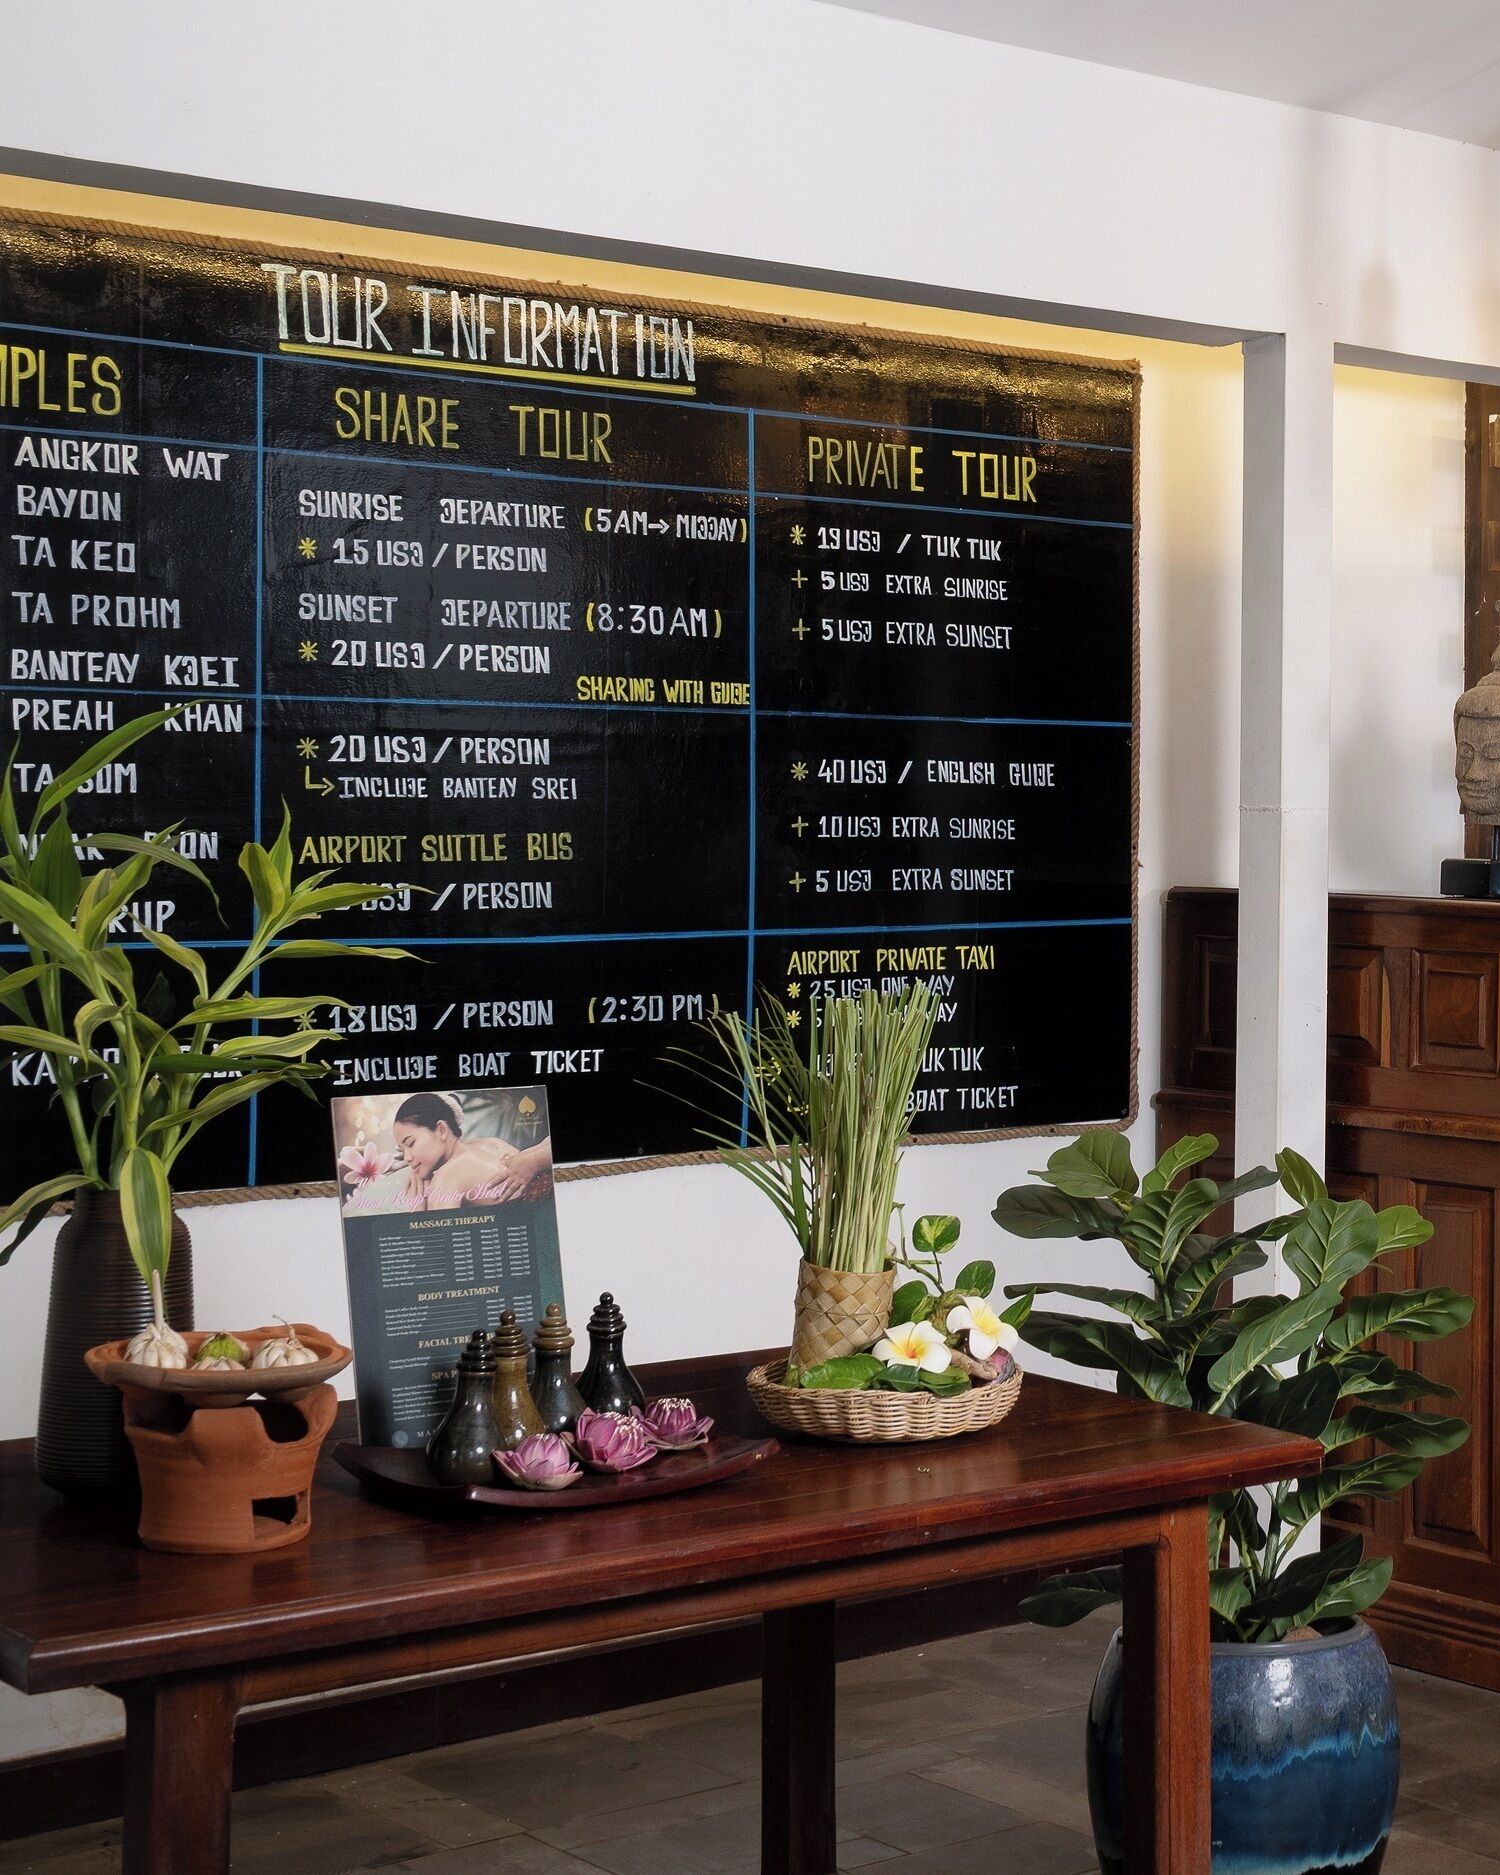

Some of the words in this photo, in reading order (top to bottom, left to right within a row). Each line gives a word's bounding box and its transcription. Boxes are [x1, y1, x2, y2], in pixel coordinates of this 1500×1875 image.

[261, 263, 393, 351] TOUR
[407, 284, 696, 381] INFORMATION
[0, 344, 121, 416] PLES
[335, 387, 460, 450] SHARE
[509, 405, 612, 464] TOUR
[14, 437, 139, 476] ANGKOR
[163, 448, 229, 481] WAT
[808, 436, 924, 492] PRIVATE
[952, 450, 1037, 503] TOUR
[17, 485, 121, 522] BAYON
[299, 489, 404, 522] SUNRISE
[440, 498, 565, 530] DEPARTURE
[12, 534, 56, 568] TA
[71, 542, 136, 573] KEO
[333, 538, 369, 566] 15
[377, 541, 423, 567] USD
[455, 544, 547, 573] PERSON
[846, 529, 880, 552] USD
[921, 535, 960, 559] TUK
[967, 538, 1002, 561] TUK
[821, 571, 835, 590] 5
[839, 572, 869, 592] USD
[886, 574, 932, 596] EXTRA
[944, 577, 1008, 601] SUNRISE
[12, 592, 54, 624] TA
[72, 595, 181, 629] PROHM
[299, 593, 398, 624] SUNSET
[441, 599, 571, 631] DEPARTURE
[821, 619, 834, 640] 5
[838, 619, 872, 643] USD
[886, 621, 936, 646] EXTRA
[946, 623, 1012, 650] SUNSET
[11, 649, 139, 682] BANTEAY
[331, 640, 365, 668] 20
[376, 642, 425, 669] USD
[459, 644, 551, 674] PERSON
[576, 676, 655, 702] SHARING
[663, 679, 703, 704] WITH
[711, 681, 750, 705] GUIDE
[12, 698, 114, 731] PREAH
[164, 702, 243, 733] KHAN
[328, 735, 365, 762] 20
[374, 735, 426, 763] USD
[460, 737, 550, 766] PERSON
[13, 763, 55, 793] TA
[338, 776, 428, 799] INCLUDE
[442, 777, 517, 799] BANTEAY
[532, 777, 577, 800] SREI
[818, 759, 845, 784] 40
[850, 759, 886, 785] USD
[927, 760, 995, 785] ENGLISH
[1009, 763, 1055, 787] GUIDE
[818, 816, 843, 838] 10
[847, 816, 881, 838] USD
[892, 816, 939, 839] EXTRA
[949, 817, 1016, 840] SUNRISE
[299, 835, 406, 865] AIRPORT
[421, 833, 507, 862] SUTTLE
[528, 832, 573, 861] BUS
[463, 882, 552, 910] PERSON
[815, 870, 830, 892] 5
[836, 869, 872, 892] USD
[892, 868, 943, 891] EXTRA
[950, 868, 1014, 892] SUNSET
[787, 950, 860, 975] AIRPORT
[877, 947, 947, 971] PRIVATE
[955, 945, 995, 970] TAXI
[809, 980, 843, 999] 25
[329, 1005, 366, 1033] 18
[370, 1004, 417, 1032] USD
[463, 1000, 553, 1029] PERSON
[332, 1055, 438, 1085] INCLUDE
[458, 1052, 510, 1077] BOAT
[530, 1049, 604, 1074] TICKET
[949, 1047, 984, 1071] TUK
[957, 1085, 1018, 1110] TICKET
[409, 1217, 453, 1230] MASSAGE
[454, 1215, 496, 1227] THERAPY
[418, 1290, 444, 1301] BODY
[446, 1285, 500, 1299] TREATMENT
[418, 1338, 452, 1348] FACIAL
